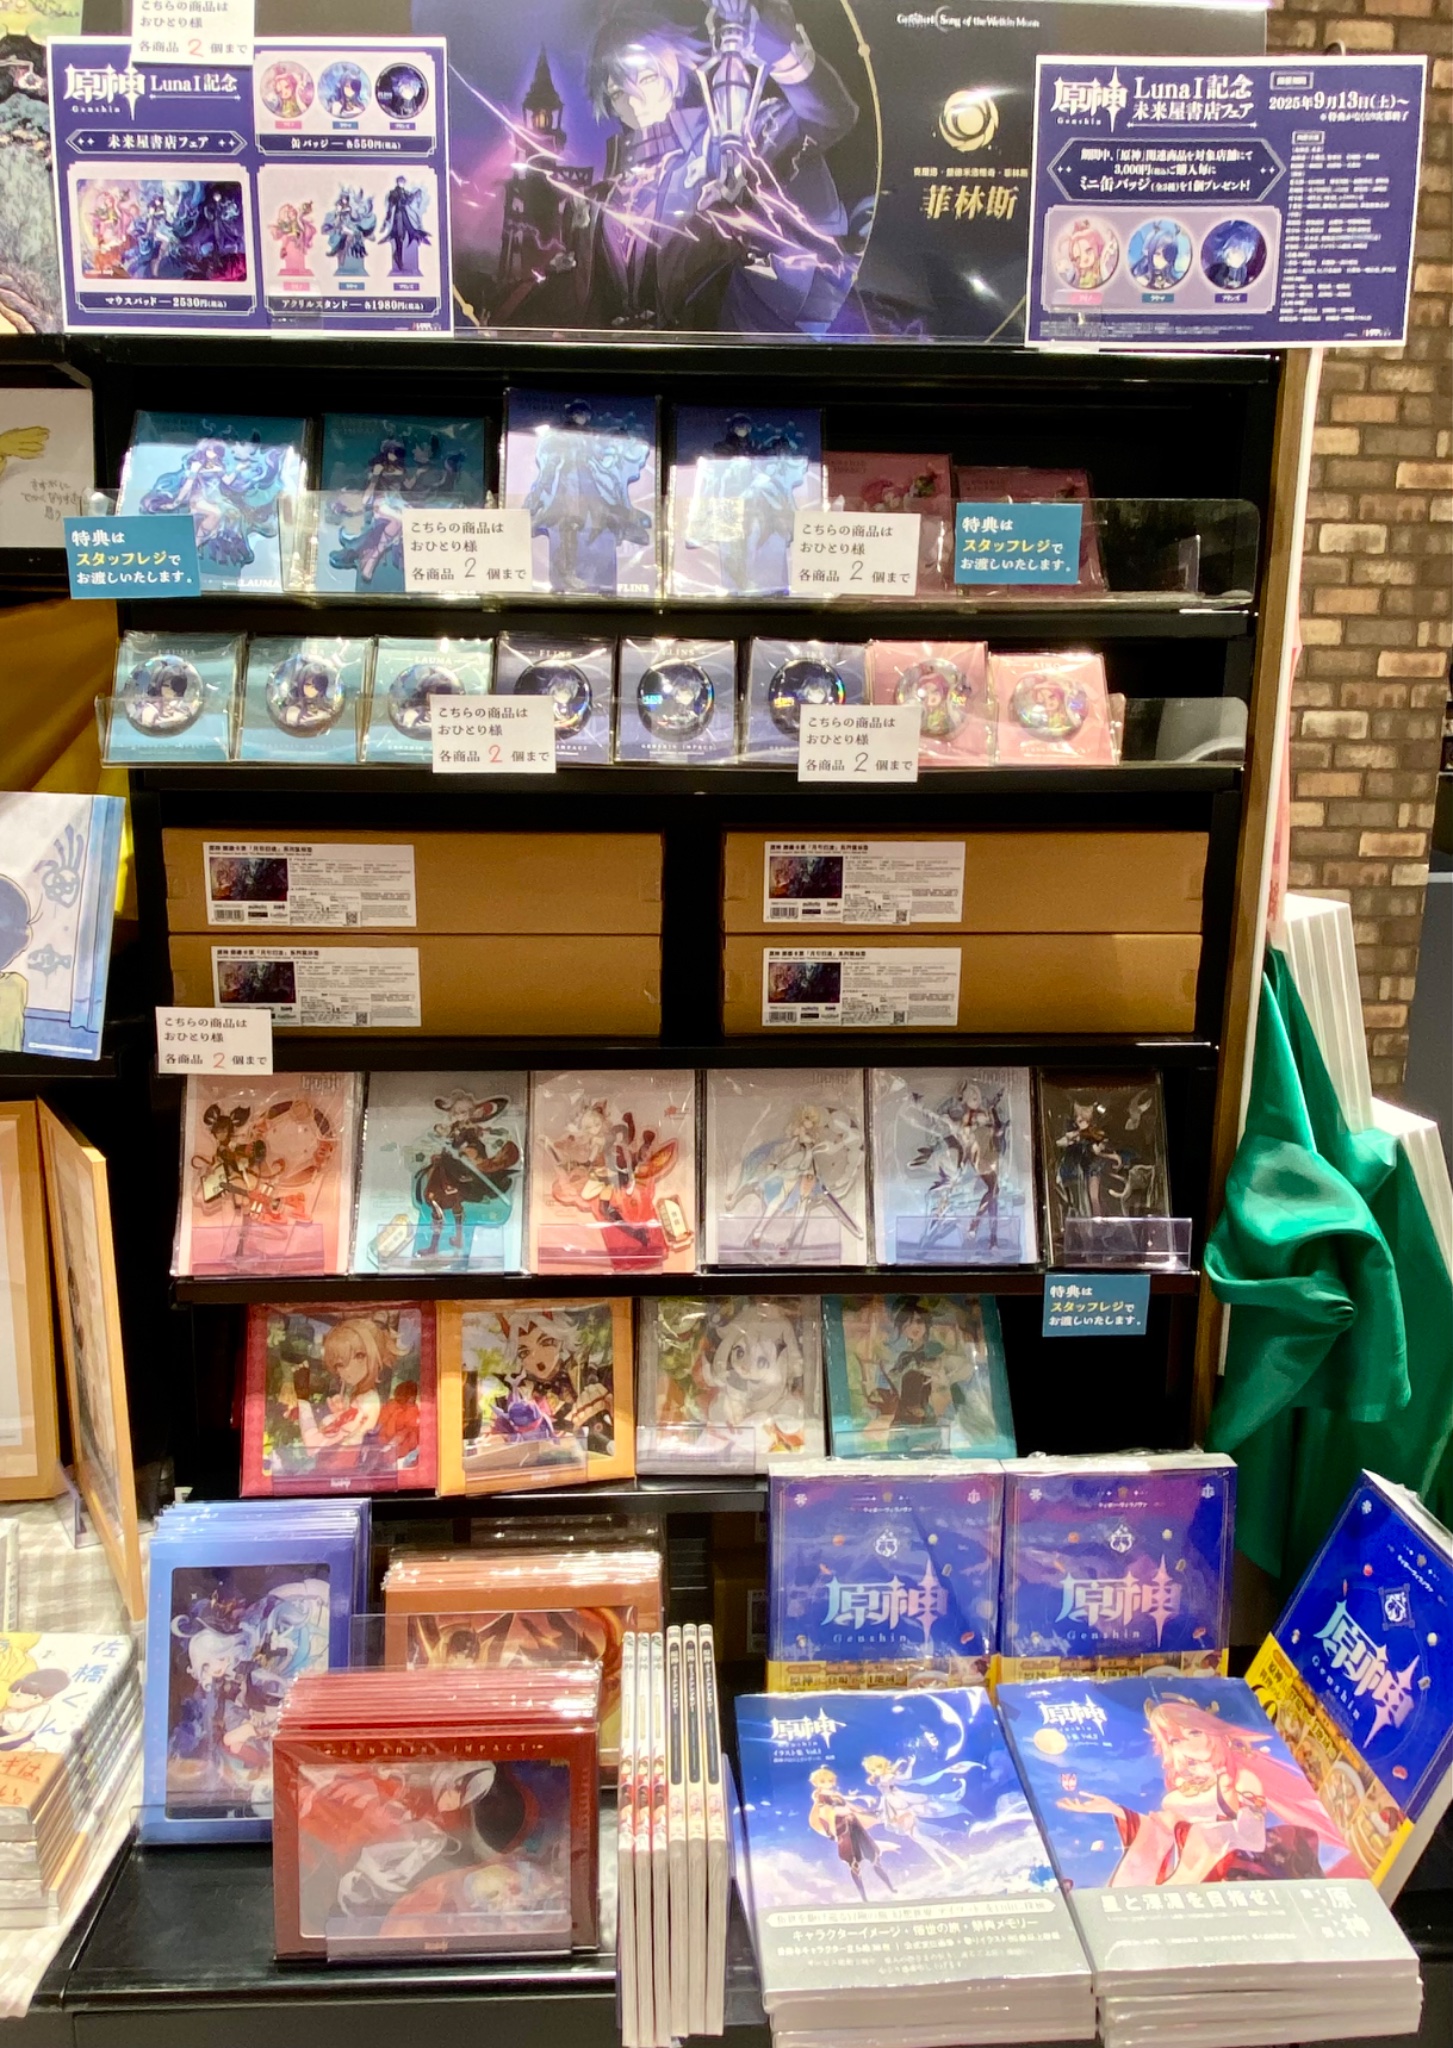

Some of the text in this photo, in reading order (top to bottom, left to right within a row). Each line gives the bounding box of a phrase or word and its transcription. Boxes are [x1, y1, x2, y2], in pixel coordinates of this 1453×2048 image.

[141, 0, 229, 12] こちらの商品は
[140, 17, 203, 29] おひとり様
[140, 38, 248, 57] 各商品 2 個まで
[63, 53, 145, 120] 原神
[151, 75, 192, 92] Luna
[204, 73, 238, 93] 記念
[1134, 76, 1192, 99] Luna
[1206, 73, 1254, 100] 記念
[1050, 66, 1128, 133] 原神
[1132, 101, 1254, 121] 未来屋書店フェア
[108, 134, 209, 150] 未来屋書店フェア
[105, 295, 158, 306] マウスパッド
[410, 522, 504, 535] こちらの商品は
[802, 524, 894, 538] こちらの商品は
[962, 516, 1013, 533] 特典は
[71, 530, 126, 547] 特典は
[410, 540, 478, 552] おひとり様
[800, 542, 866, 555] おひとり様
[963, 539, 1064, 555] スタッフレジで
[76, 551, 181, 567] スタッフレジで
[960, 557, 1071, 573] お渡しいたします。
[412, 557, 527, 581] 各商品 2 個まで
[800, 560, 912, 584] 各商品 2 個まで
[76, 571, 193, 585] お渡しいたします。
[438, 706, 528, 720] こちらの商品は
[438, 724, 503, 737] おひとり様
[807, 716, 896, 730] こちらの商品は
[806, 733, 869, 746] おひとり様
[440, 744, 550, 764] 各商品 2 個まで
[806, 752, 914, 772] 各商品 2 個まで
[164, 1018, 248, 1029] こちらの商品は
[164, 1032, 224, 1043] おひとり様
[165, 1052, 268, 1070] 各商品 2 個まで
[1050, 1284, 1094, 1298] 特典は
[1050, 1301, 1136, 1313] スタッフレジで
[1049, 1315, 1142, 1327] お渡しいたします。
[820, 1556, 949, 1645] 原神
[1055, 1553, 1182, 1648] 原神
[833, 1632, 907, 1644] Genshin
[1067, 1630, 1140, 1640] Genshin
[1313, 1599, 1421, 1749] 原神
[38, 1639, 125, 1736] 佐橋くん
[1312, 1654, 1360, 1720] Genshin
[1036, 1693, 1108, 1736] 原神
[770, 1707, 837, 1749] 原神
[1325, 1886, 1371, 1938] 原神
